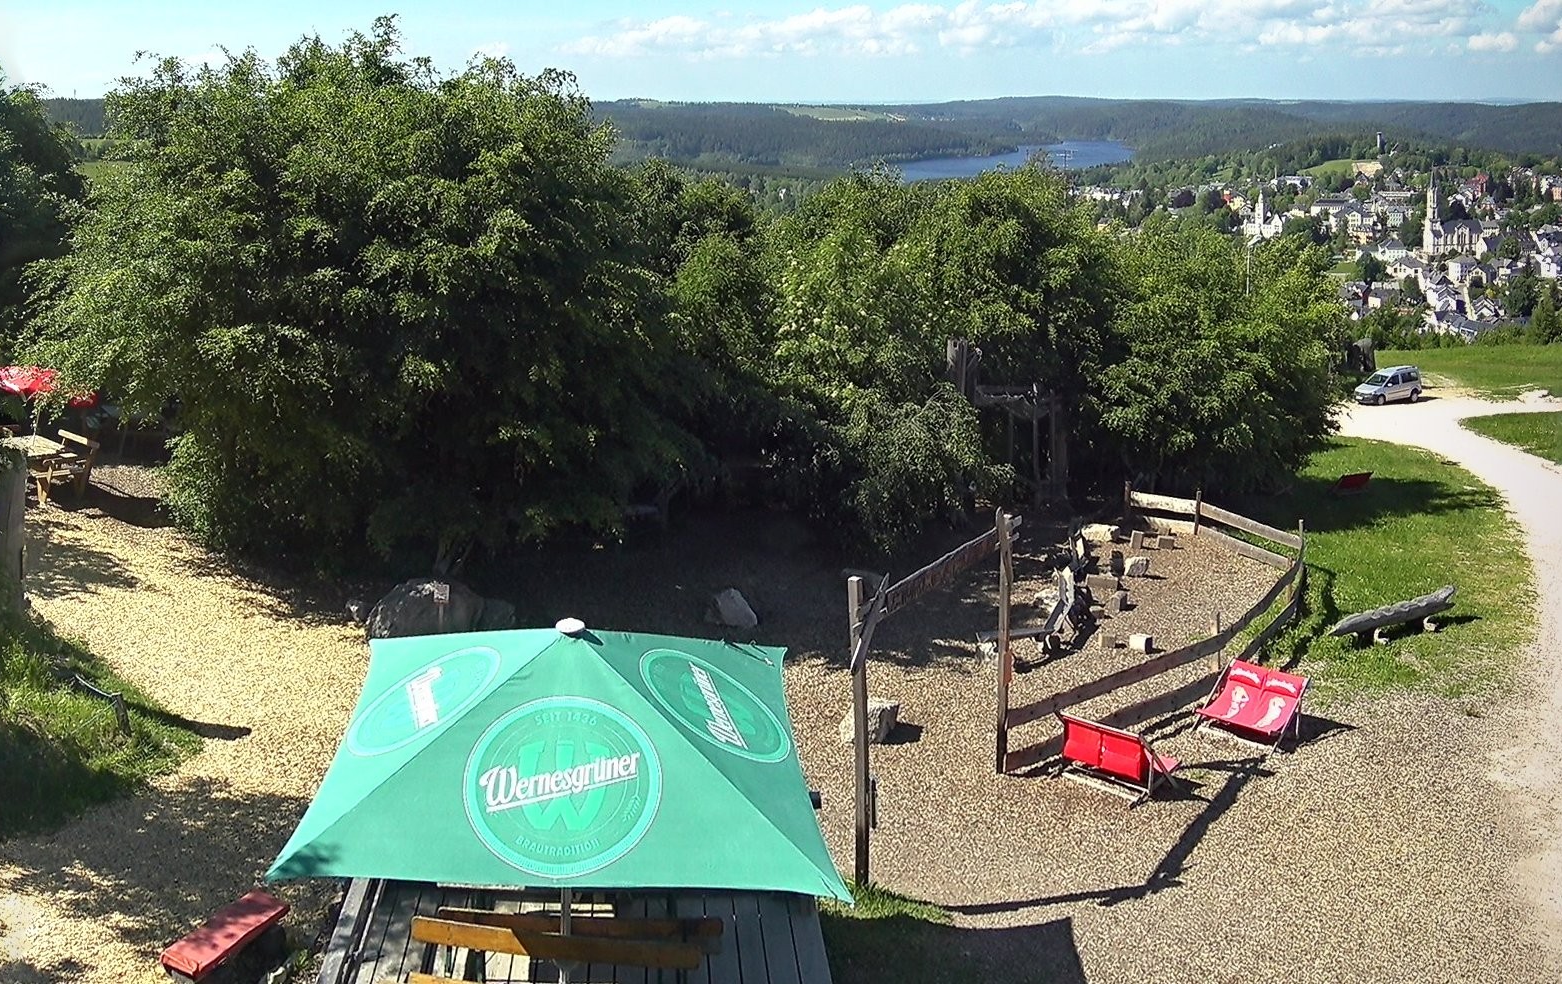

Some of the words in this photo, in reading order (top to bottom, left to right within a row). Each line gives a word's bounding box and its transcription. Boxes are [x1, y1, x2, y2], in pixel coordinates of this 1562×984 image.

[535, 711, 561, 726] SEIT
[567, 711, 598, 726] 1436
[514, 835, 600, 857] BRAUTRADITION
